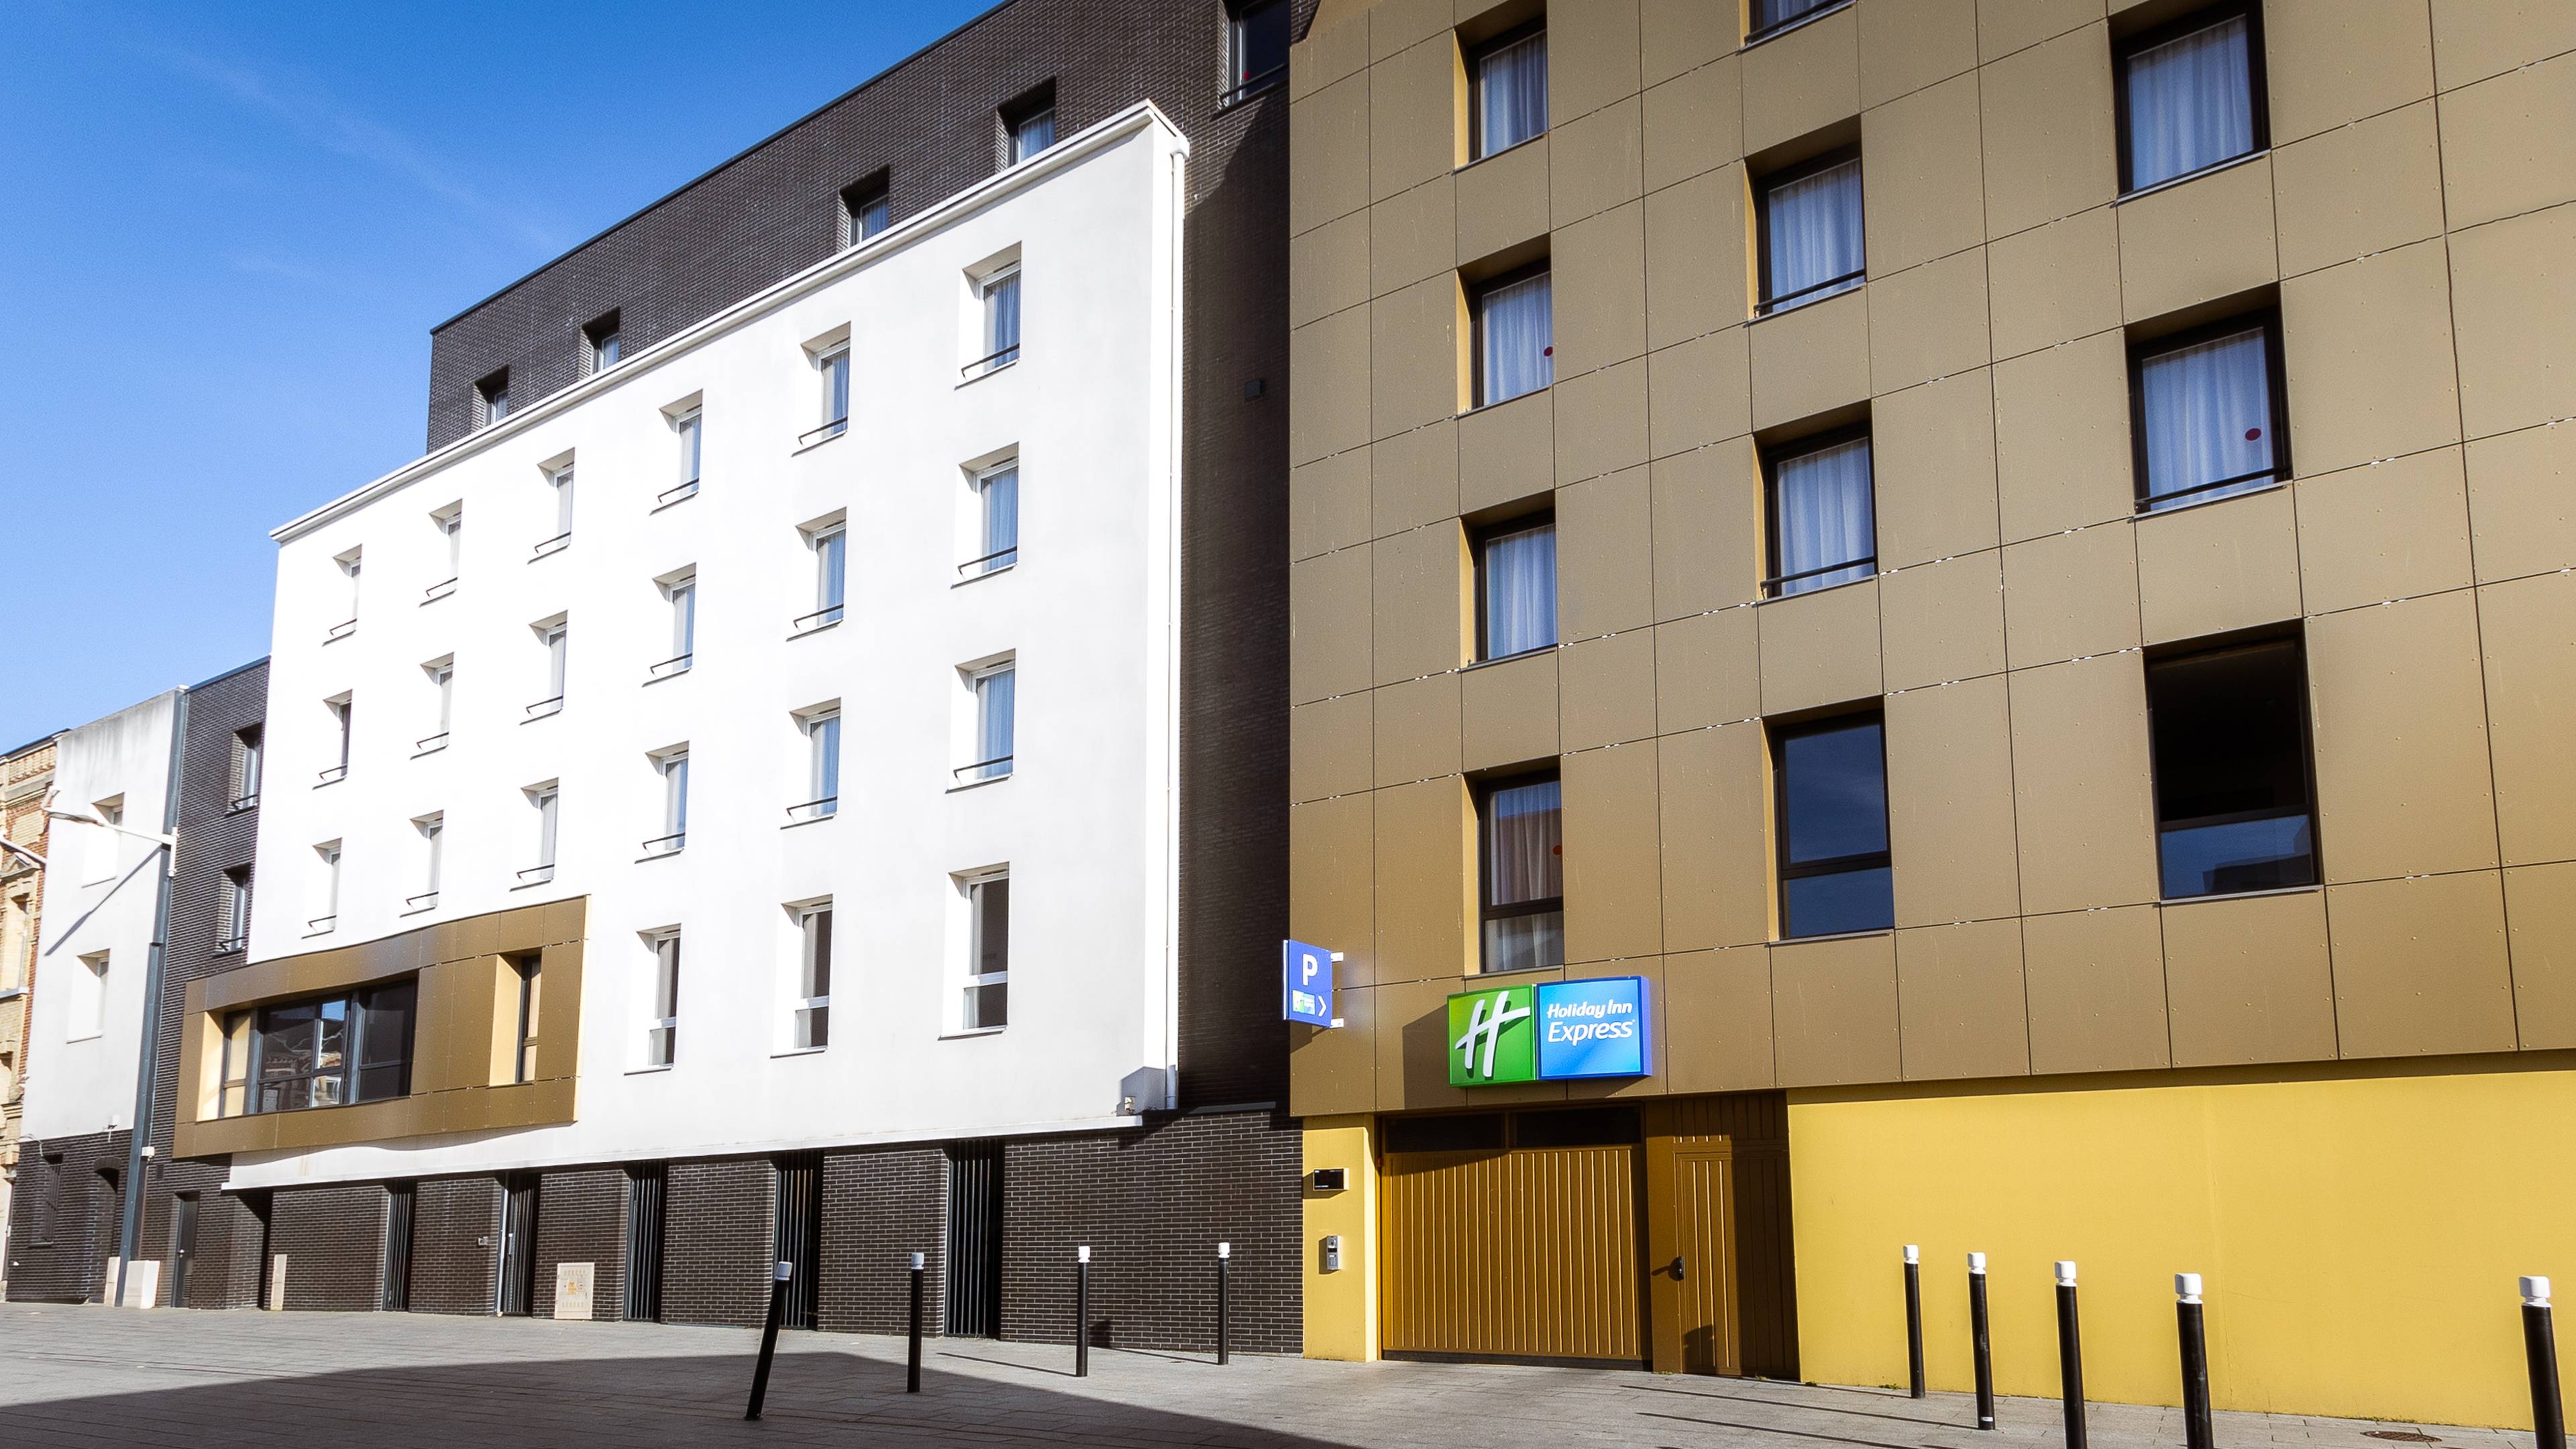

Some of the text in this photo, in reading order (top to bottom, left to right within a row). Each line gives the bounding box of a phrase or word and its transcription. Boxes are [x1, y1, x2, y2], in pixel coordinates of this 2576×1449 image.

[1302, 953, 1318, 986] P
[1547, 999, 1633, 1019] Holiday Inn
[1454, 990, 1530, 1077] H
[1548, 1021, 1633, 1046] Express
